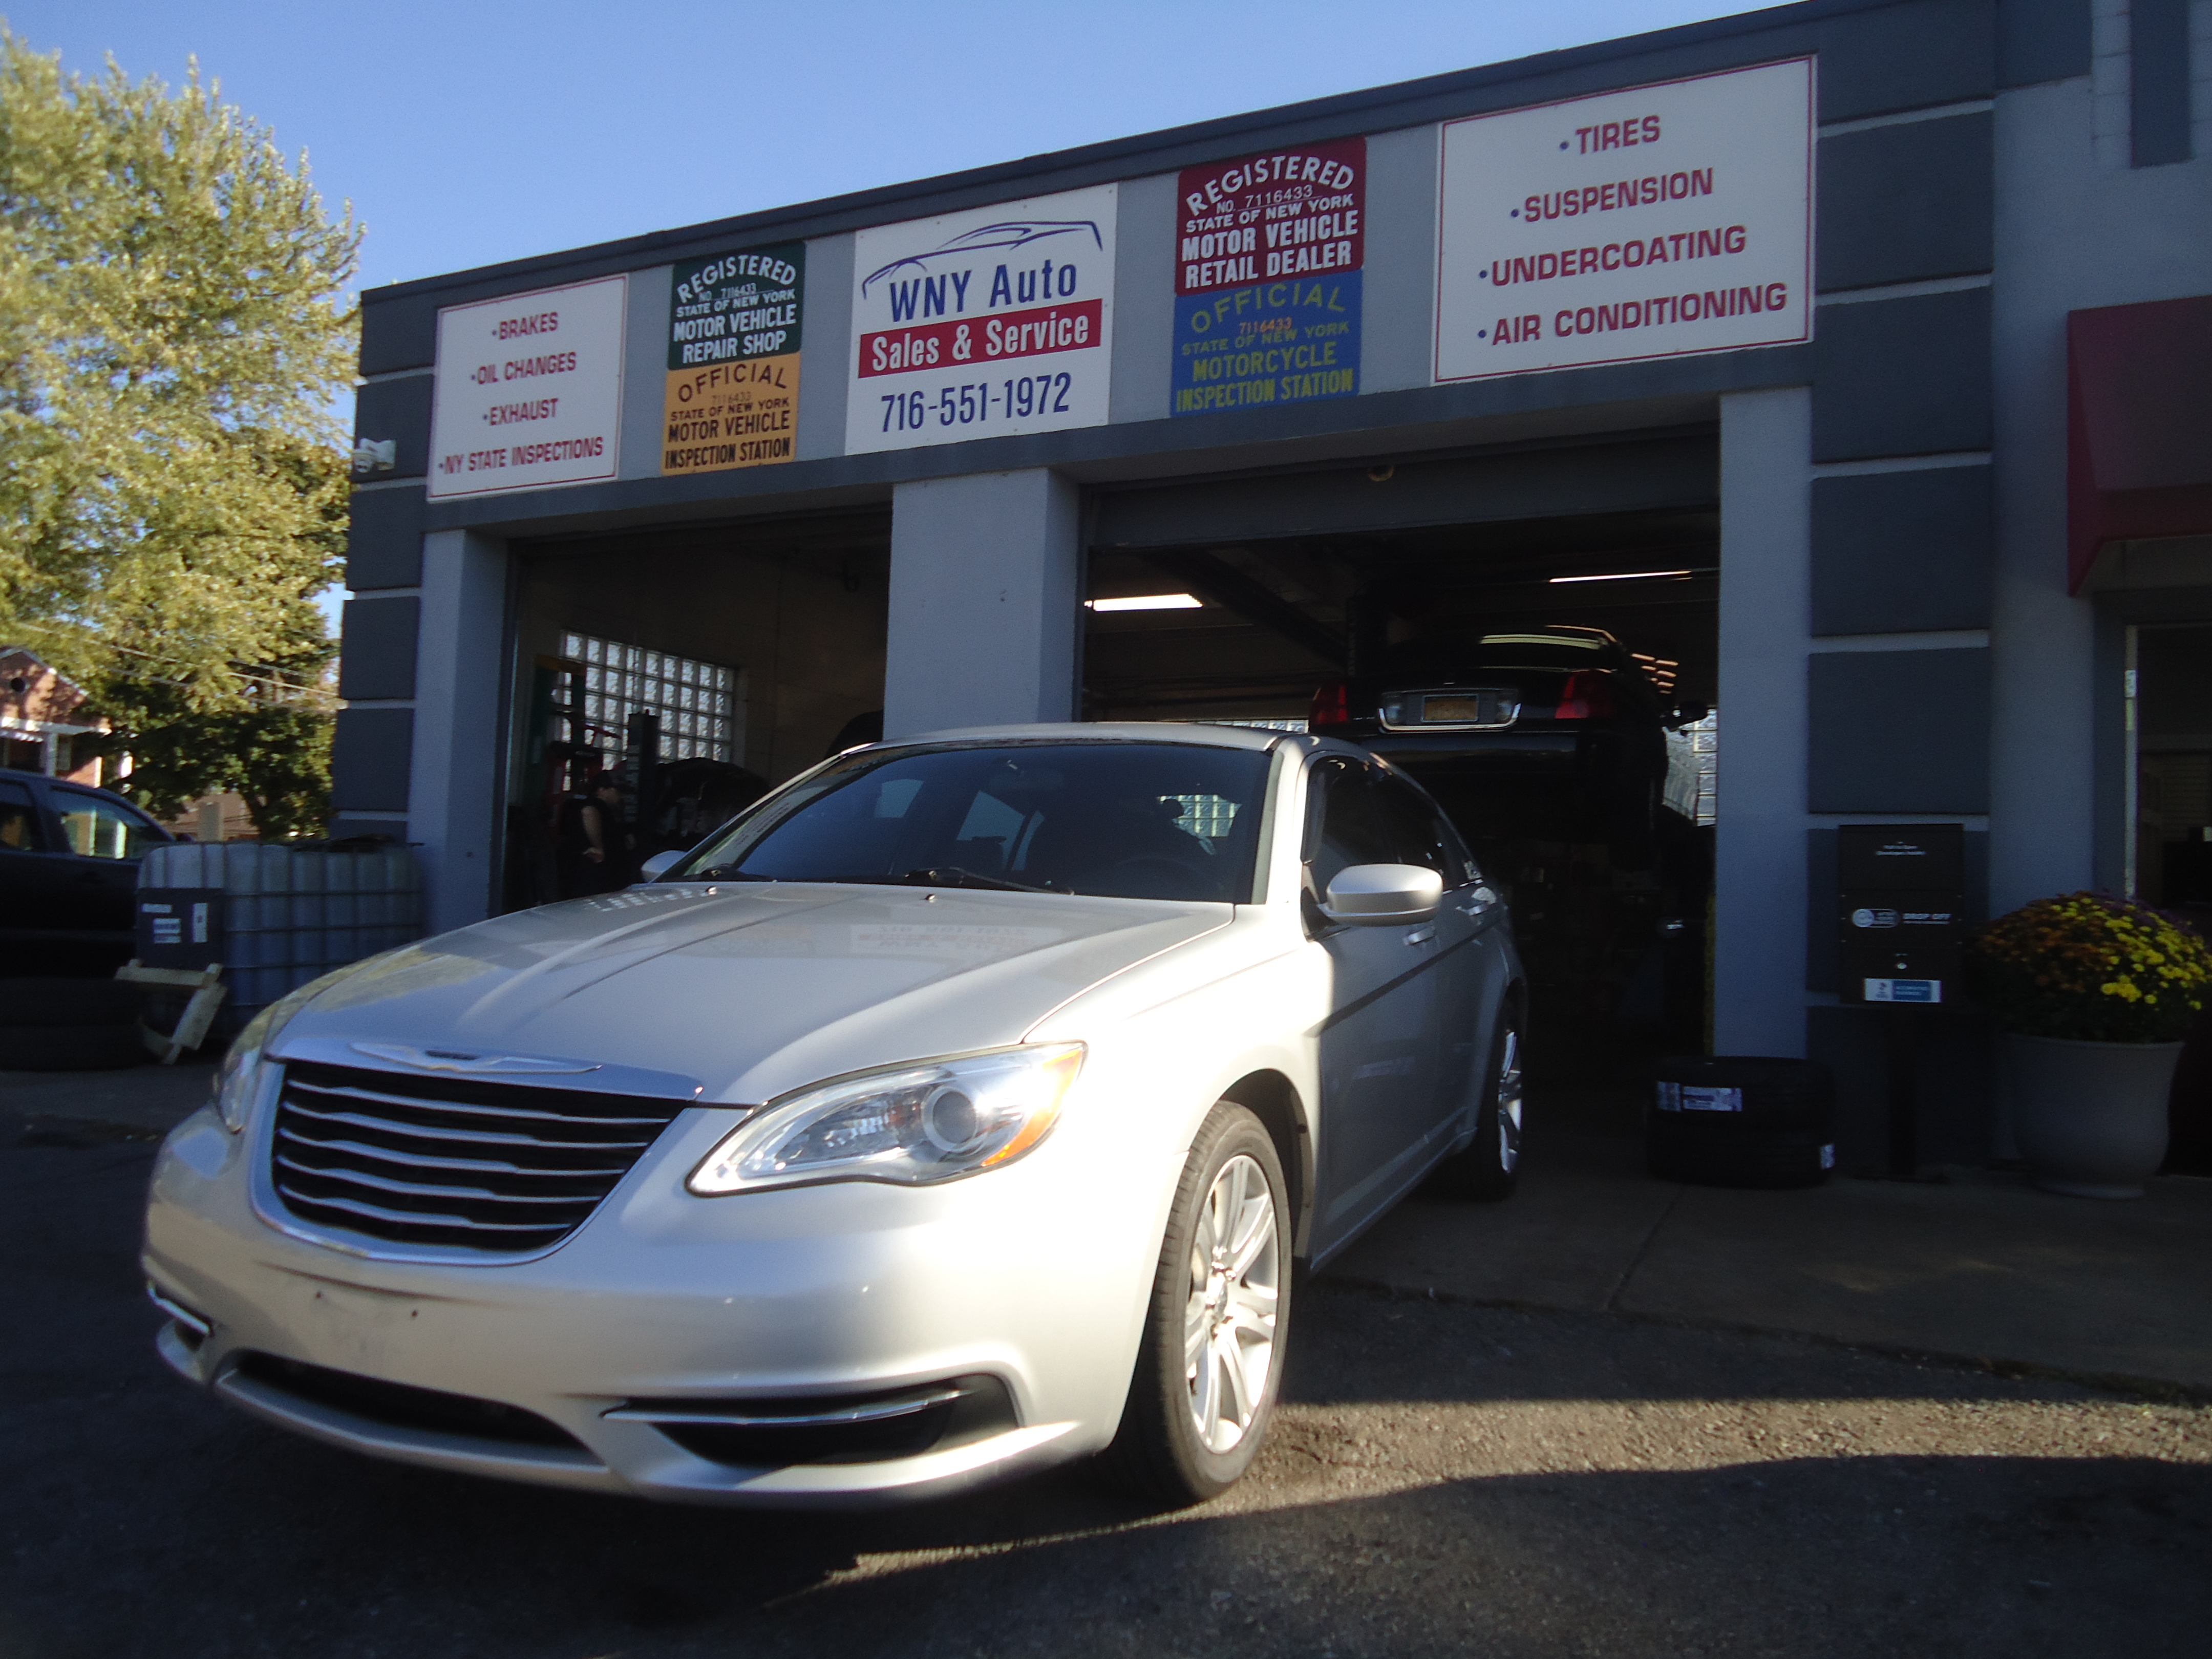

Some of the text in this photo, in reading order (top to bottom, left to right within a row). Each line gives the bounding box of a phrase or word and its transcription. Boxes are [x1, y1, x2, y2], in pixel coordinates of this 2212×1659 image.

[1576, 115, 1661, 154] TIRES
[1186, 156, 1354, 216] REGISTERED
[1245, 184, 1313, 208] 7116433
[1524, 167, 1713, 222] SUSPENSION
[1186, 194, 1353, 233] STATE OF NEW YORK
[1181, 210, 1358, 262] MOTOR VEHICLE
[1492, 225, 1747, 286] UNDERCOATING
[677, 254, 796, 303] REGISTERED
[1185, 240, 1352, 289] RETAIL DEALER
[676, 289, 795, 317] STATE OF NEW YORK
[890, 260, 1076, 322] WNY Auto
[1191, 283, 1346, 333] OFFICIAL
[498, 311, 558, 340] BRAKES
[673, 304, 797, 342] MOTOR VEHICLE
[1492, 282, 1787, 345] AIR CONDITIONING
[683, 330, 787, 364] REPAIR SHOP
[872, 311, 1089, 372] Sales & Service
[1182, 321, 1349, 356] STATE OF NEW YORK
[477, 351, 576, 385] OIL CHANGES
[1193, 341, 1337, 382] MOTORCYCLE
[678, 364, 787, 402] OFFICIAL
[881, 372, 1072, 433] 716-551-1972
[1177, 367, 1354, 412] INSPECTION STATION
[490, 398, 559, 426] EXHAUST
[668, 410, 790, 443] MOTOR VEHICLE
[671, 397, 790, 421] STATE OF NEW YORK
[444, 436, 603, 474] NY STATE INSPECTIONS
[665, 437, 790, 469] INSPECTION STATION
